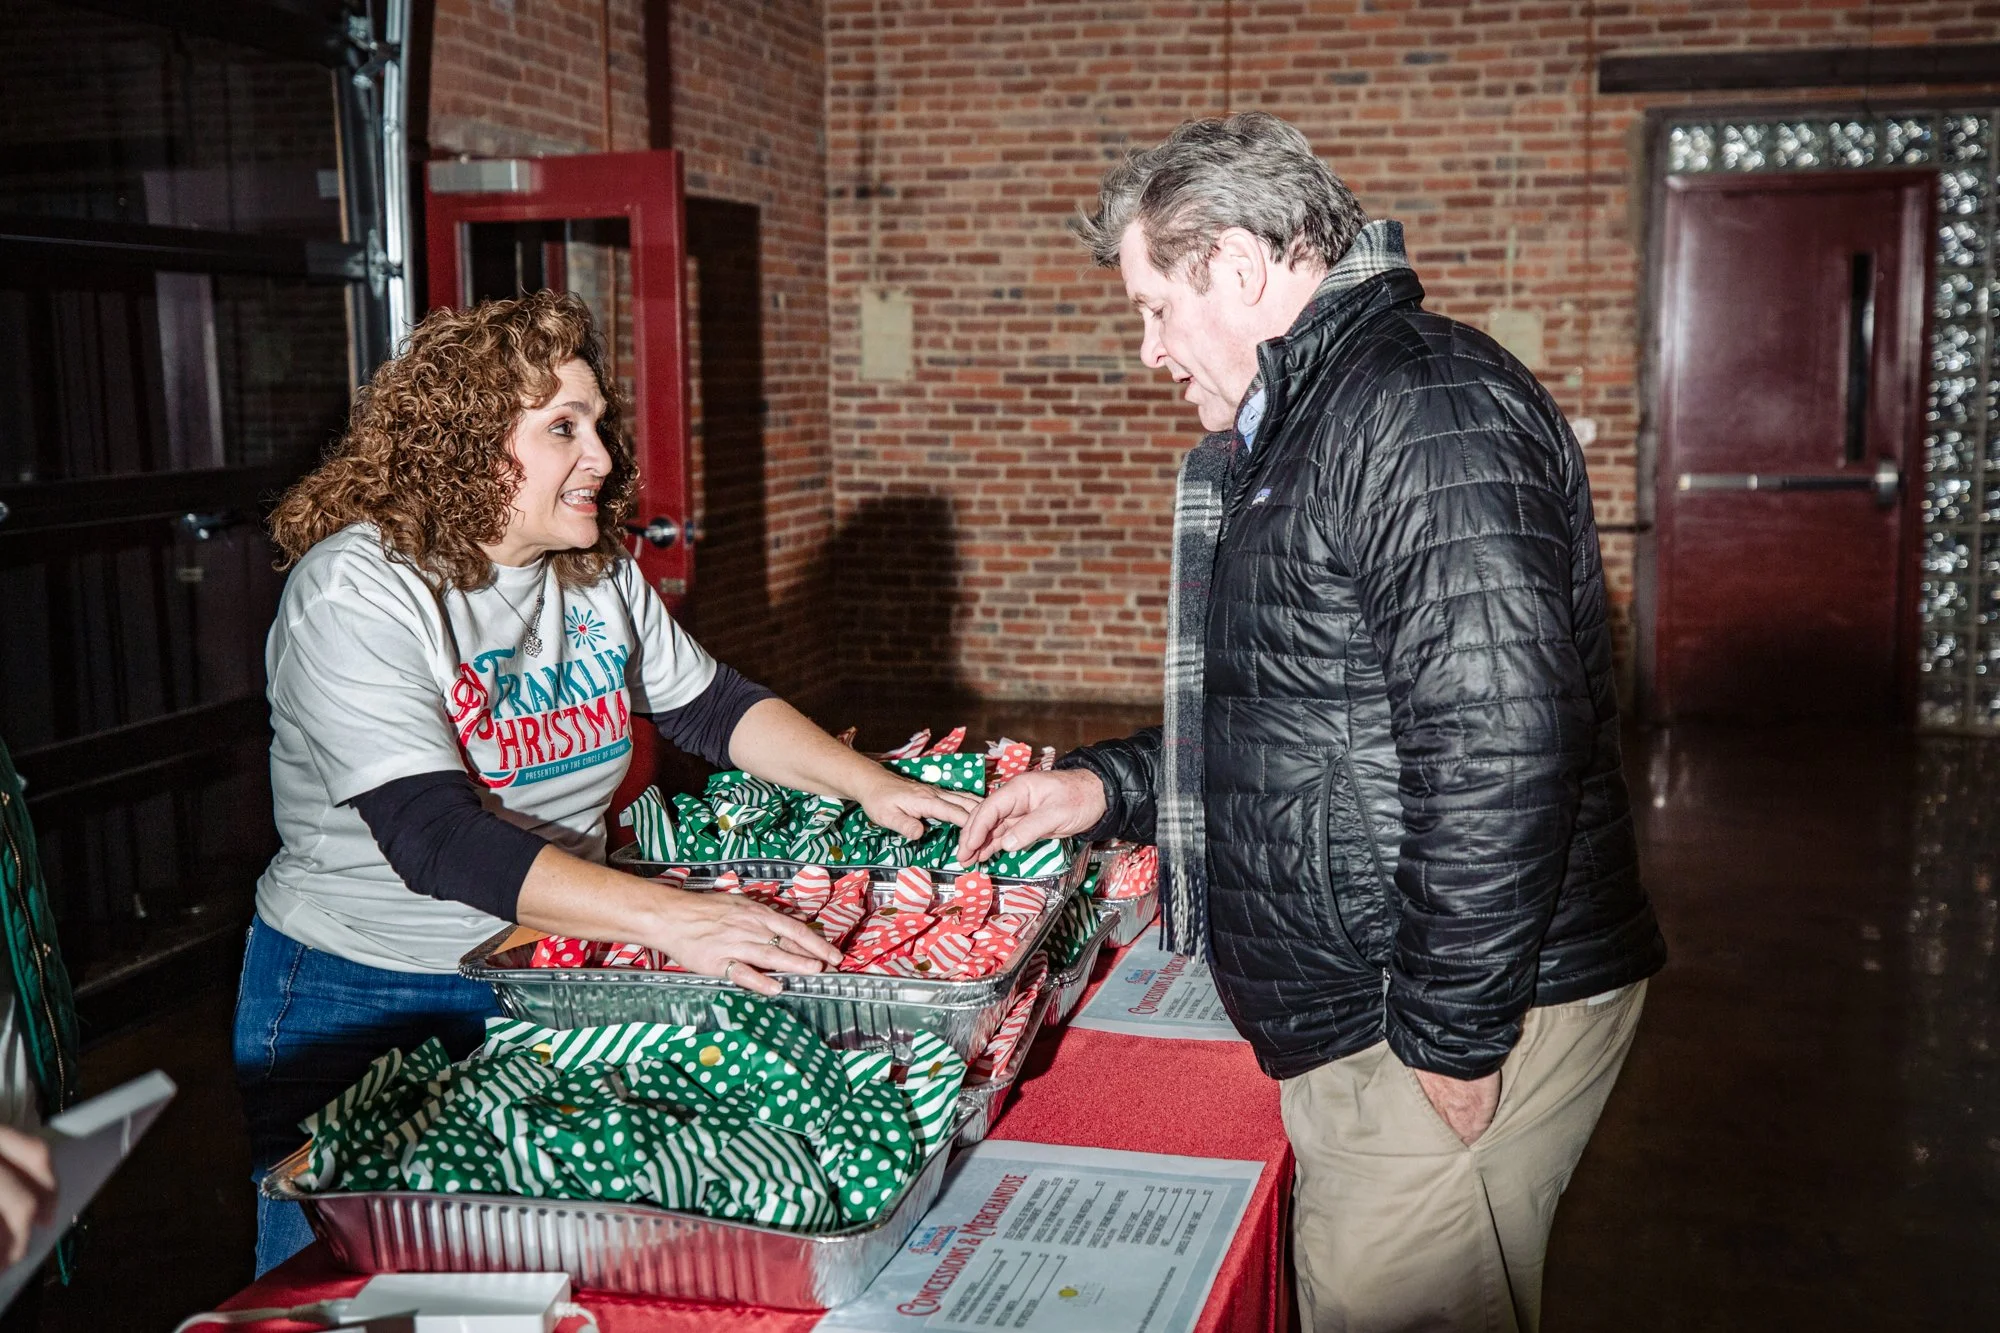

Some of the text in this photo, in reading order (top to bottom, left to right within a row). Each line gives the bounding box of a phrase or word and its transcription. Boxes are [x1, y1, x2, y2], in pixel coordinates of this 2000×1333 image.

[473, 644, 629, 718] FRANKLIN
[457, 690, 633, 788] CHRISTMA
[525, 766, 560, 780] PRESENTED
[561, 764, 569, 773] BY
[570, 760, 580, 770] THE
[582, 753, 601, 766] CIRCLE
[602, 750, 609, 760] OF
[1128, 980, 1173, 1014] CONCESSIONS
[958, 1174, 1028, 1237] MERCHANDISE
[957, 1238, 983, 1246] &
[896, 1246, 975, 1316] CONCESSIONS
